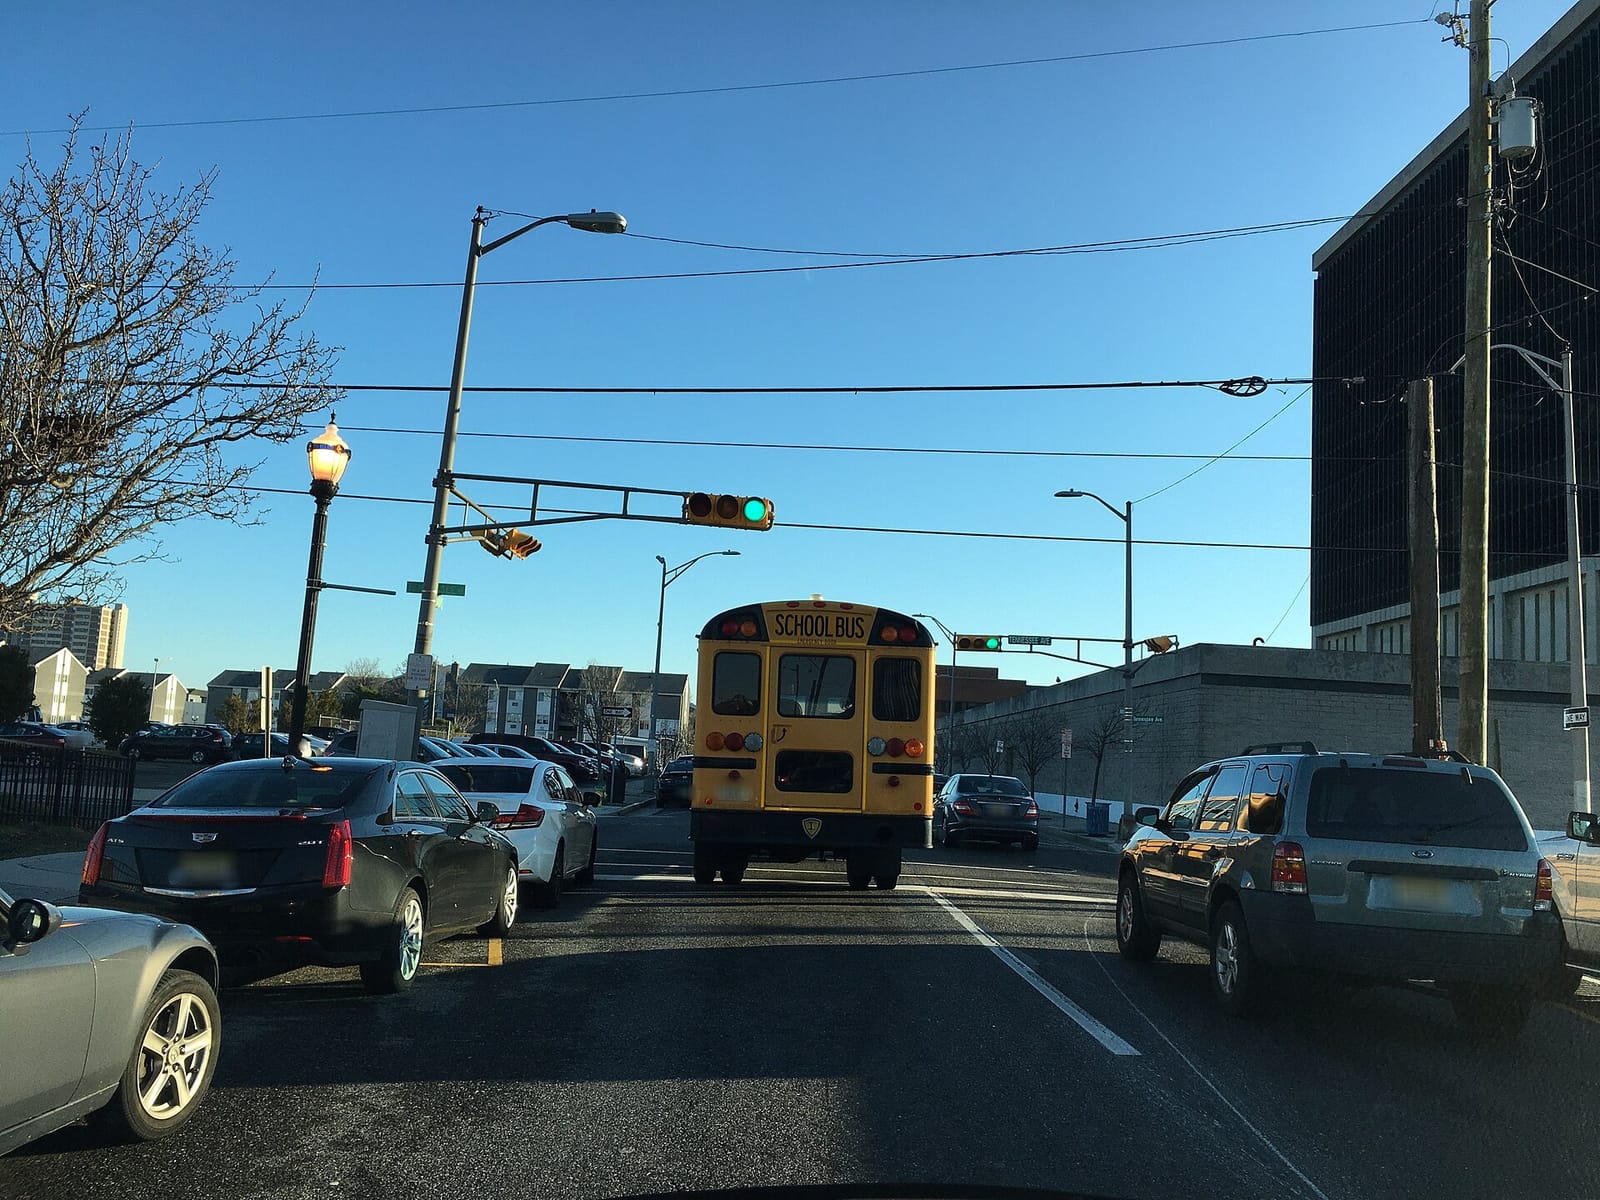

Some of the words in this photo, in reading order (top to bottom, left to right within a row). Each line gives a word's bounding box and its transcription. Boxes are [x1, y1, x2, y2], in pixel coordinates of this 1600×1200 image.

[775, 614, 833, 637] SCHOOL
[835, 616, 865, 638] BUS
[1009, 635, 1039, 644] TENNESSEE
[1040, 637, 1050, 645] AVE
[1575, 713, 1585, 721] WAY
